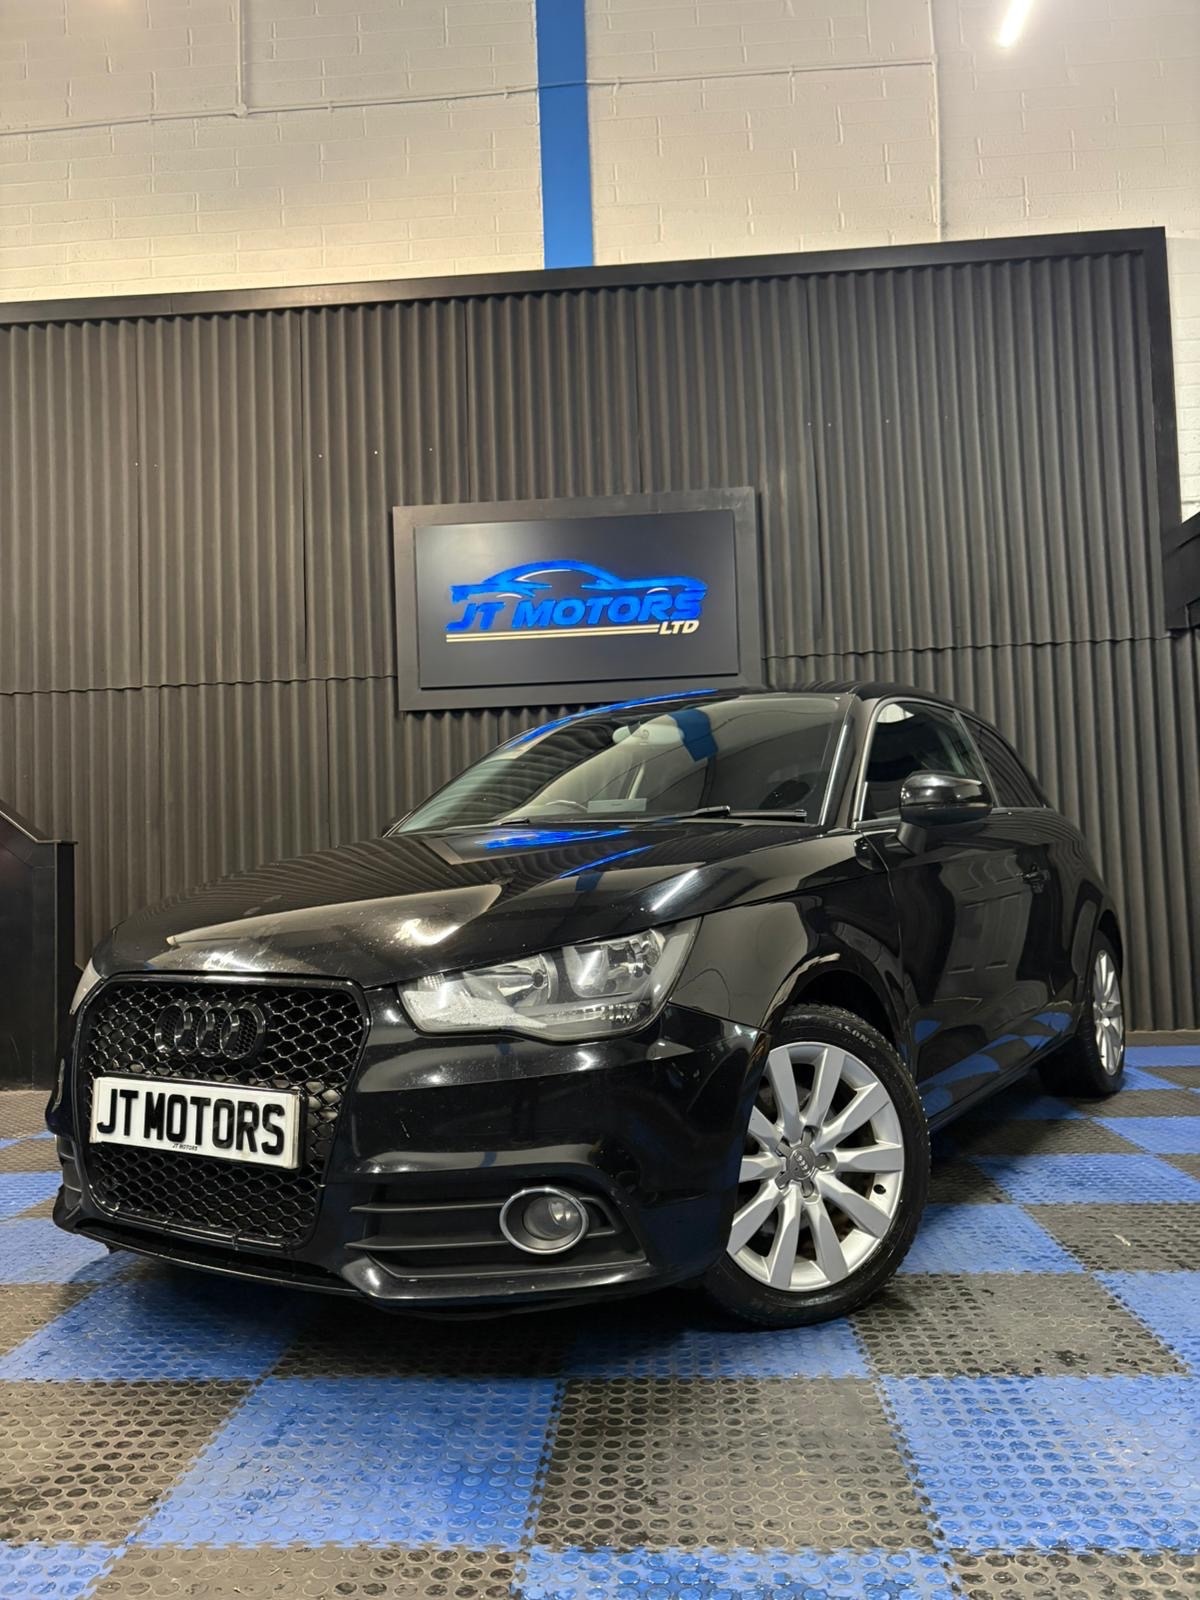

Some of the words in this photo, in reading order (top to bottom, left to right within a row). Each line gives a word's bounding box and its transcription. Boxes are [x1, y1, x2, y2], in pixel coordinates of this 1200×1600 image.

[445, 601, 506, 632] JT
[511, 590, 706, 629] MOTORS
[658, 619, 700, 635] LTD
[96, 1088, 139, 1137] JT
[143, 1091, 286, 1156] MOTORS
